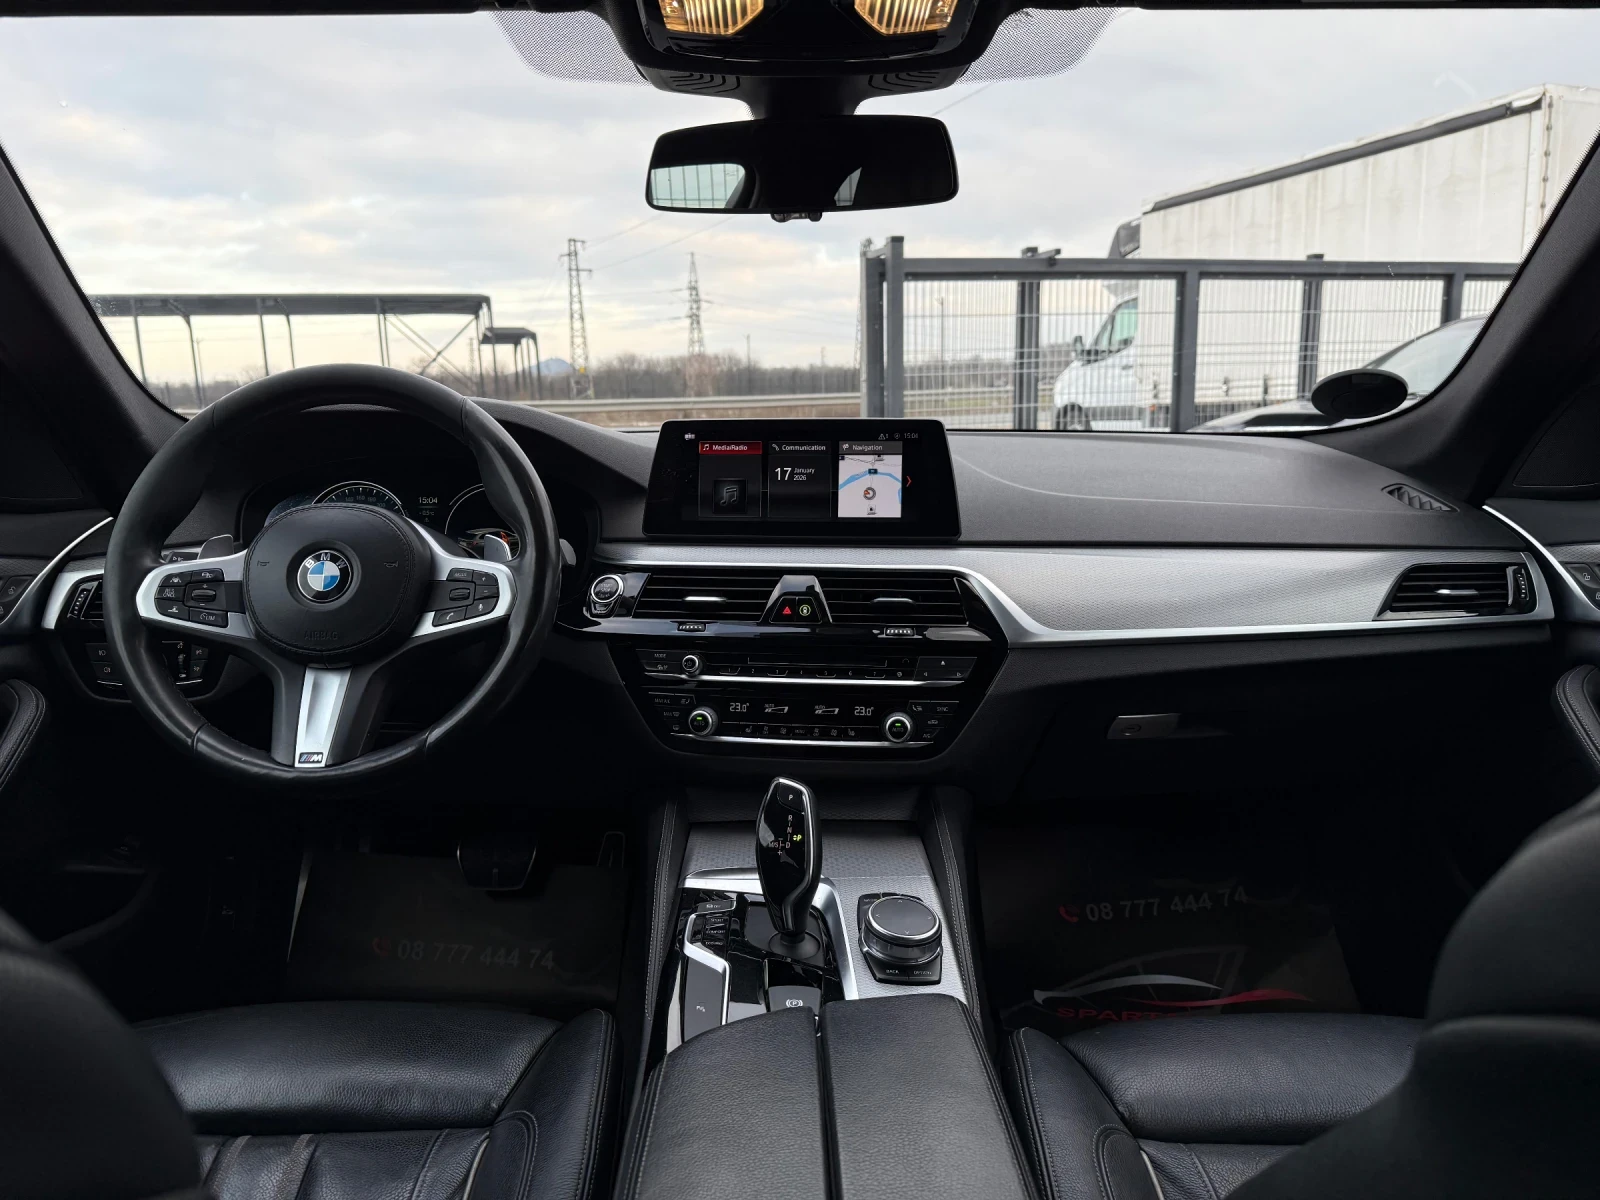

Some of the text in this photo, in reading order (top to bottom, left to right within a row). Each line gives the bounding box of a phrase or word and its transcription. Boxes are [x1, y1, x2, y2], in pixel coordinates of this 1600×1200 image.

[774, 467, 815, 481] 17 January
[418, 496, 439, 504] 15:04
[304, 552, 347, 569] BMW
[304, 631, 339, 641] AIRBAG
[1085, 886, 1247, 922] 08 777 444 74
[397, 940, 555, 971] 08 777 444 74
[1056, 1007, 1177, 1022] SPART
